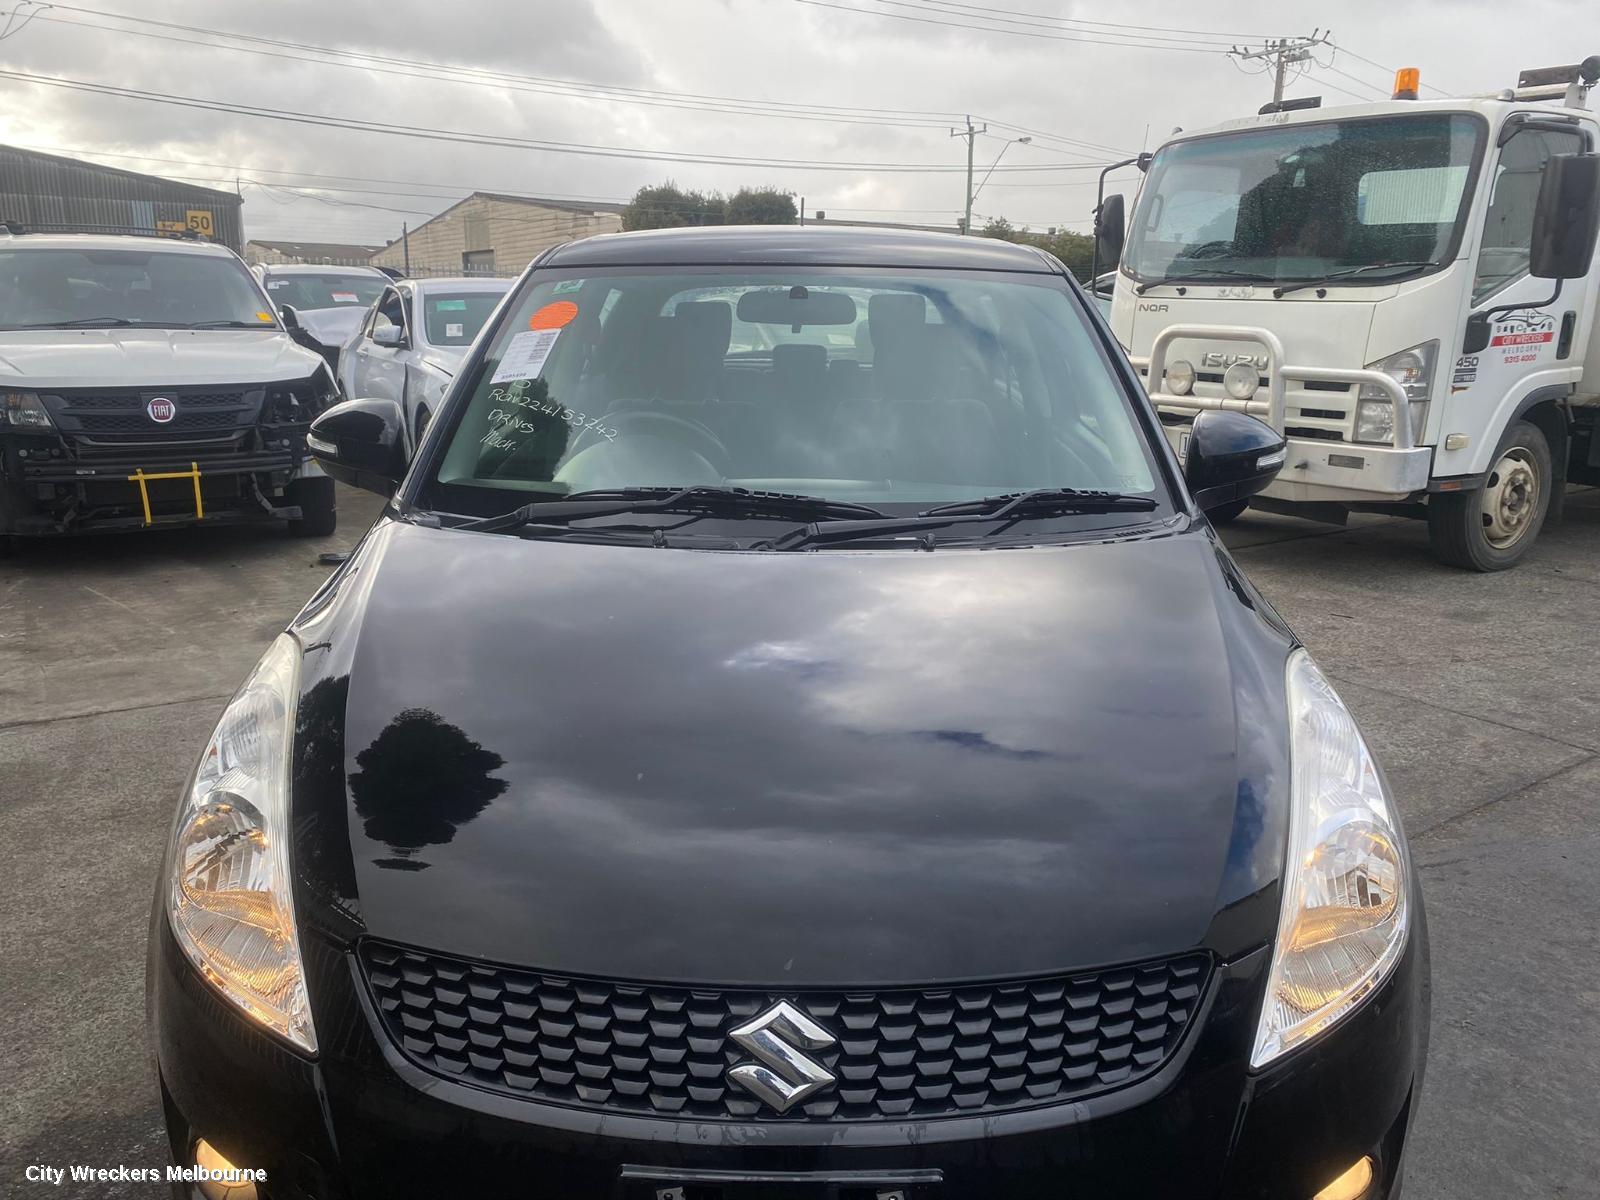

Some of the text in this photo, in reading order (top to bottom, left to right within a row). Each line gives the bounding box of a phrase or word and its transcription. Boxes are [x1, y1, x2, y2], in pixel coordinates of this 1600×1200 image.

[190, 216, 210, 229] 50
[1201, 352, 1269, 370] ISUZU
[1456, 356, 1479, 368] 450
[153, 405, 169, 417] FIAT
